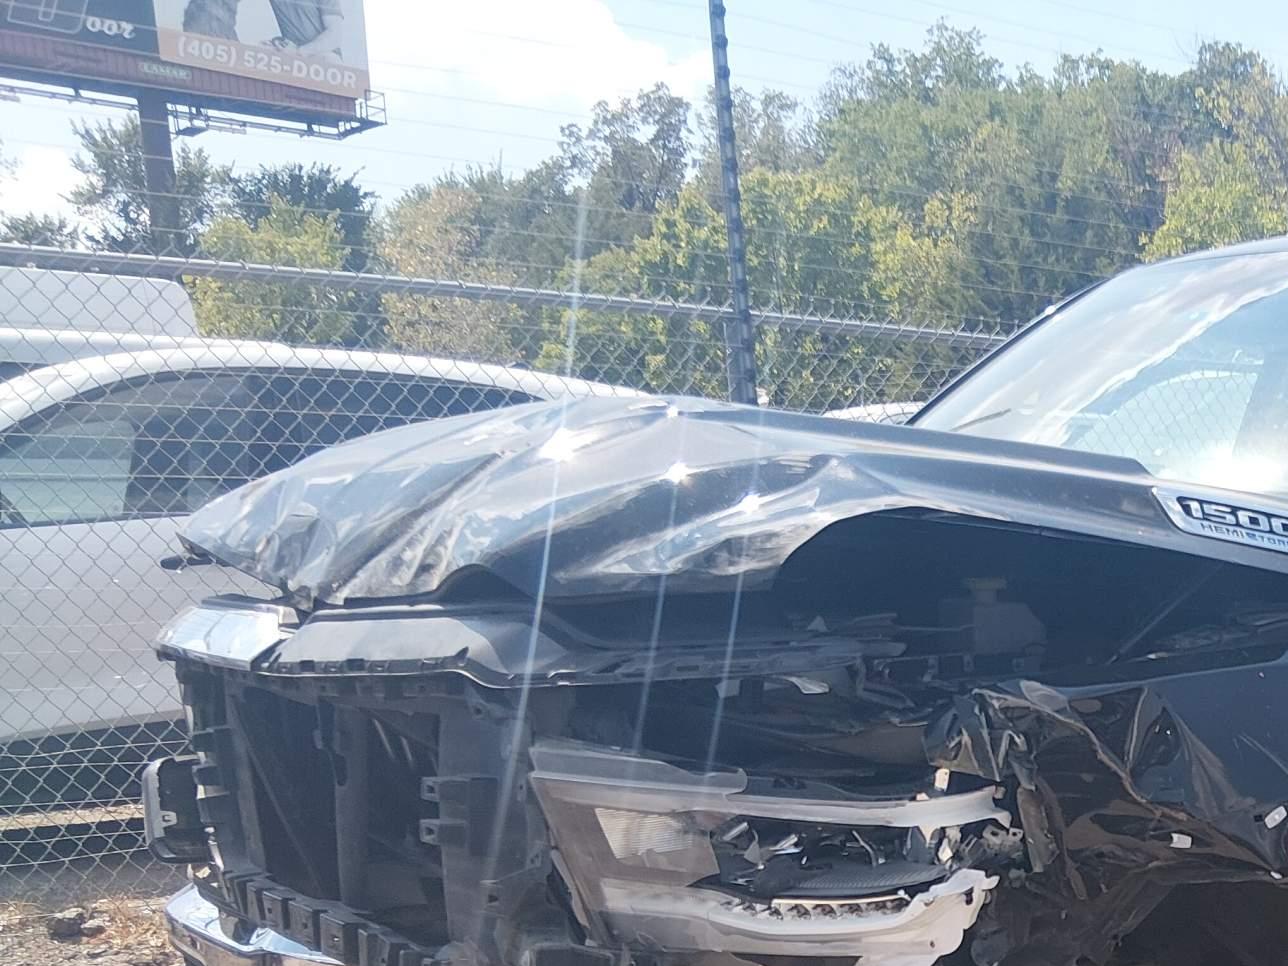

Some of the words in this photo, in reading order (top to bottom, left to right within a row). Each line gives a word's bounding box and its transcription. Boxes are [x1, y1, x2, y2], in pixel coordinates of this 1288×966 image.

[177, 36, 236, 67] (405)
[244, 51, 357, 89] 525-DOOR
[1200, 522, 1245, 539] HEMI
